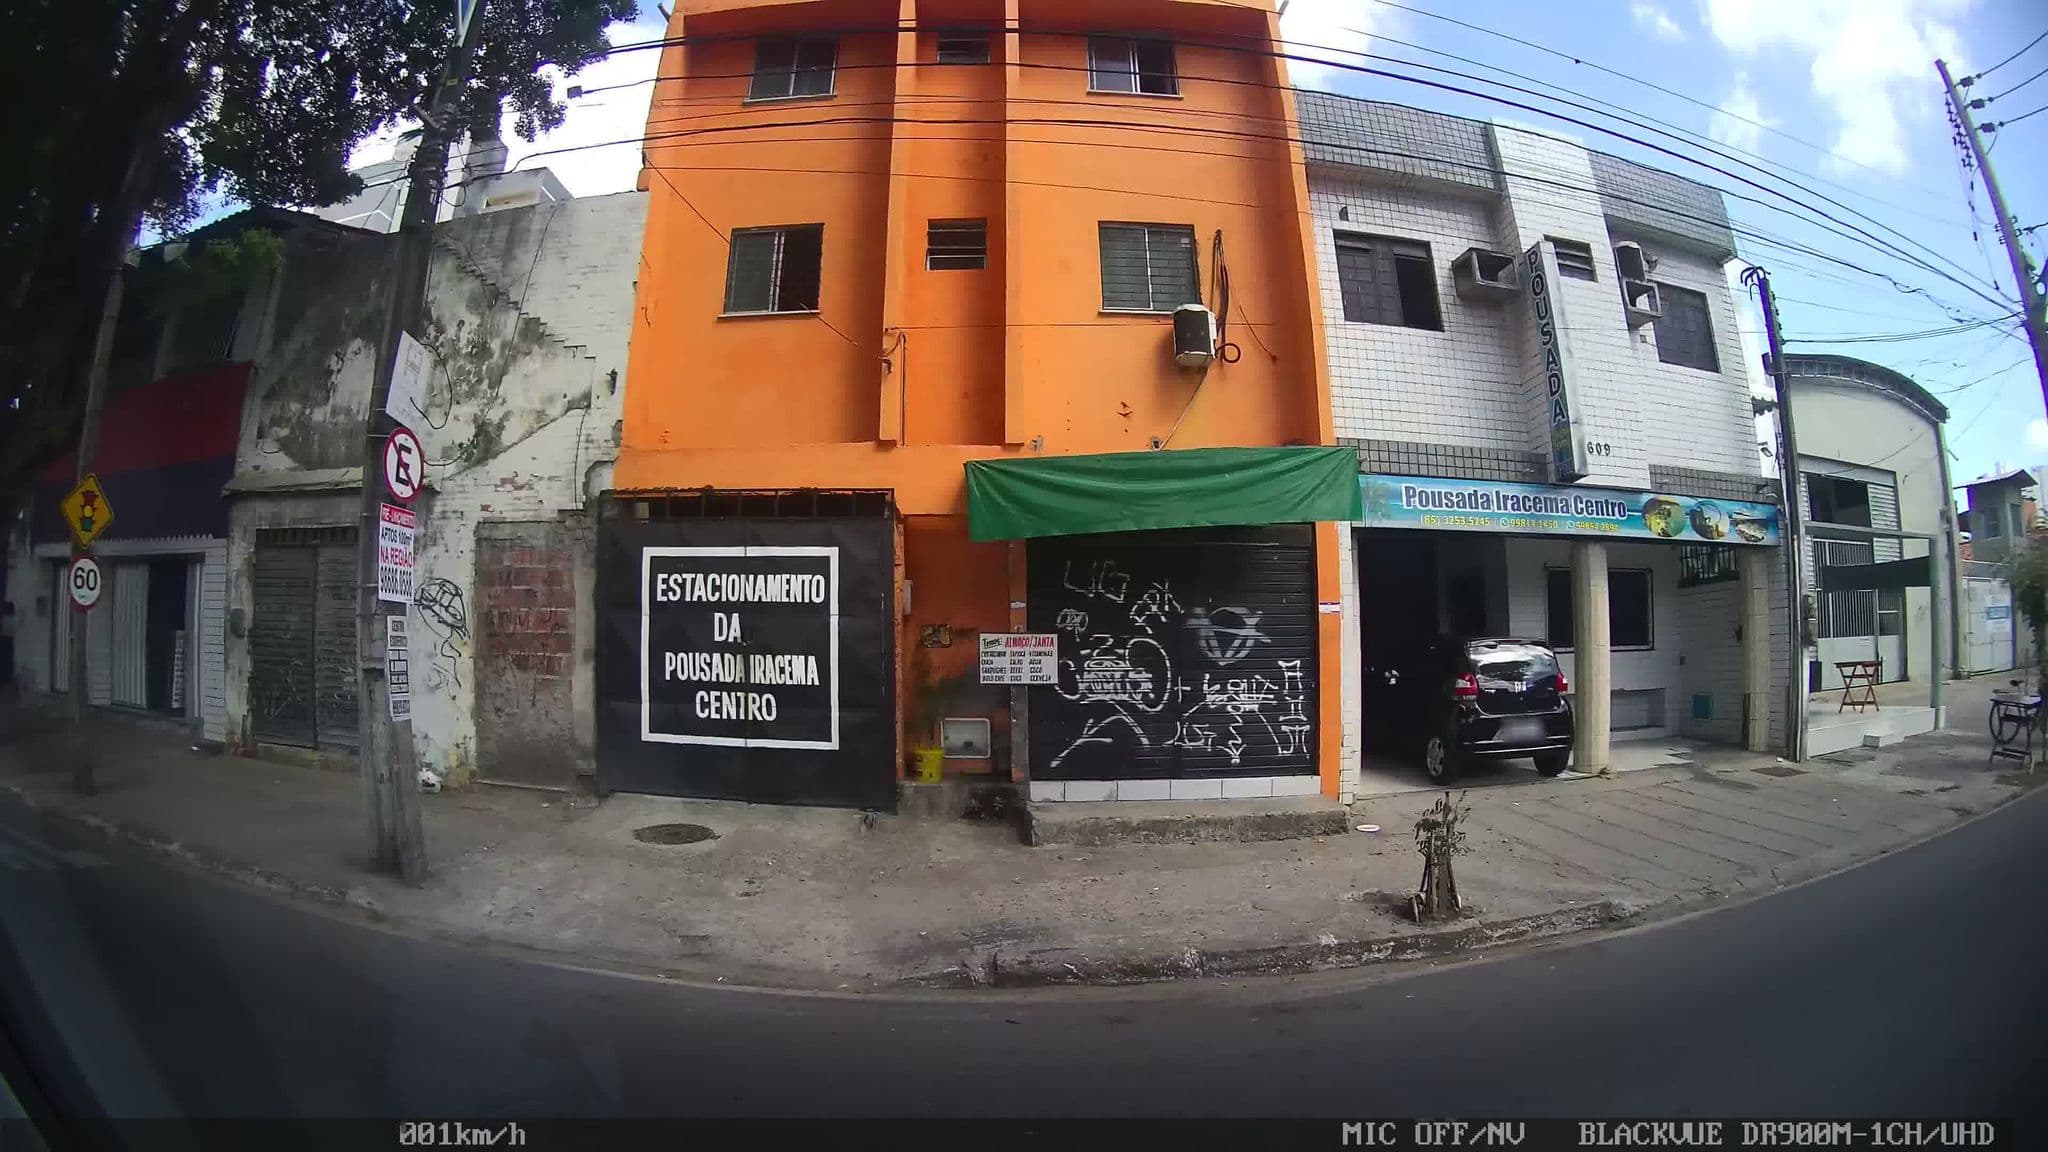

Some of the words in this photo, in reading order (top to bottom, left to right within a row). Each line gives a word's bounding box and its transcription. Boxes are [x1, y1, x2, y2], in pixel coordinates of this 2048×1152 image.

[1526, 250, 1567, 427] POUSADA
[1587, 441, 1611, 457] 609
[1402, 485, 1492, 512] Pousada
[1494, 489, 1570, 515] Iracema
[1573, 495, 1628, 519] Centro
[1420, 514, 1441, 526] (85)
[381, 545, 390, 565] NA
[390, 547, 413, 569] REGIÃO
[74, 567, 98, 590] 60
[656, 573, 825, 603] ESTACIONAMENTO
[714, 612, 742, 643] DA
[665, 652, 745, 683] POUSADA
[750, 655, 820, 685] IRACEMA
[696, 691, 777, 721] CENTRO
